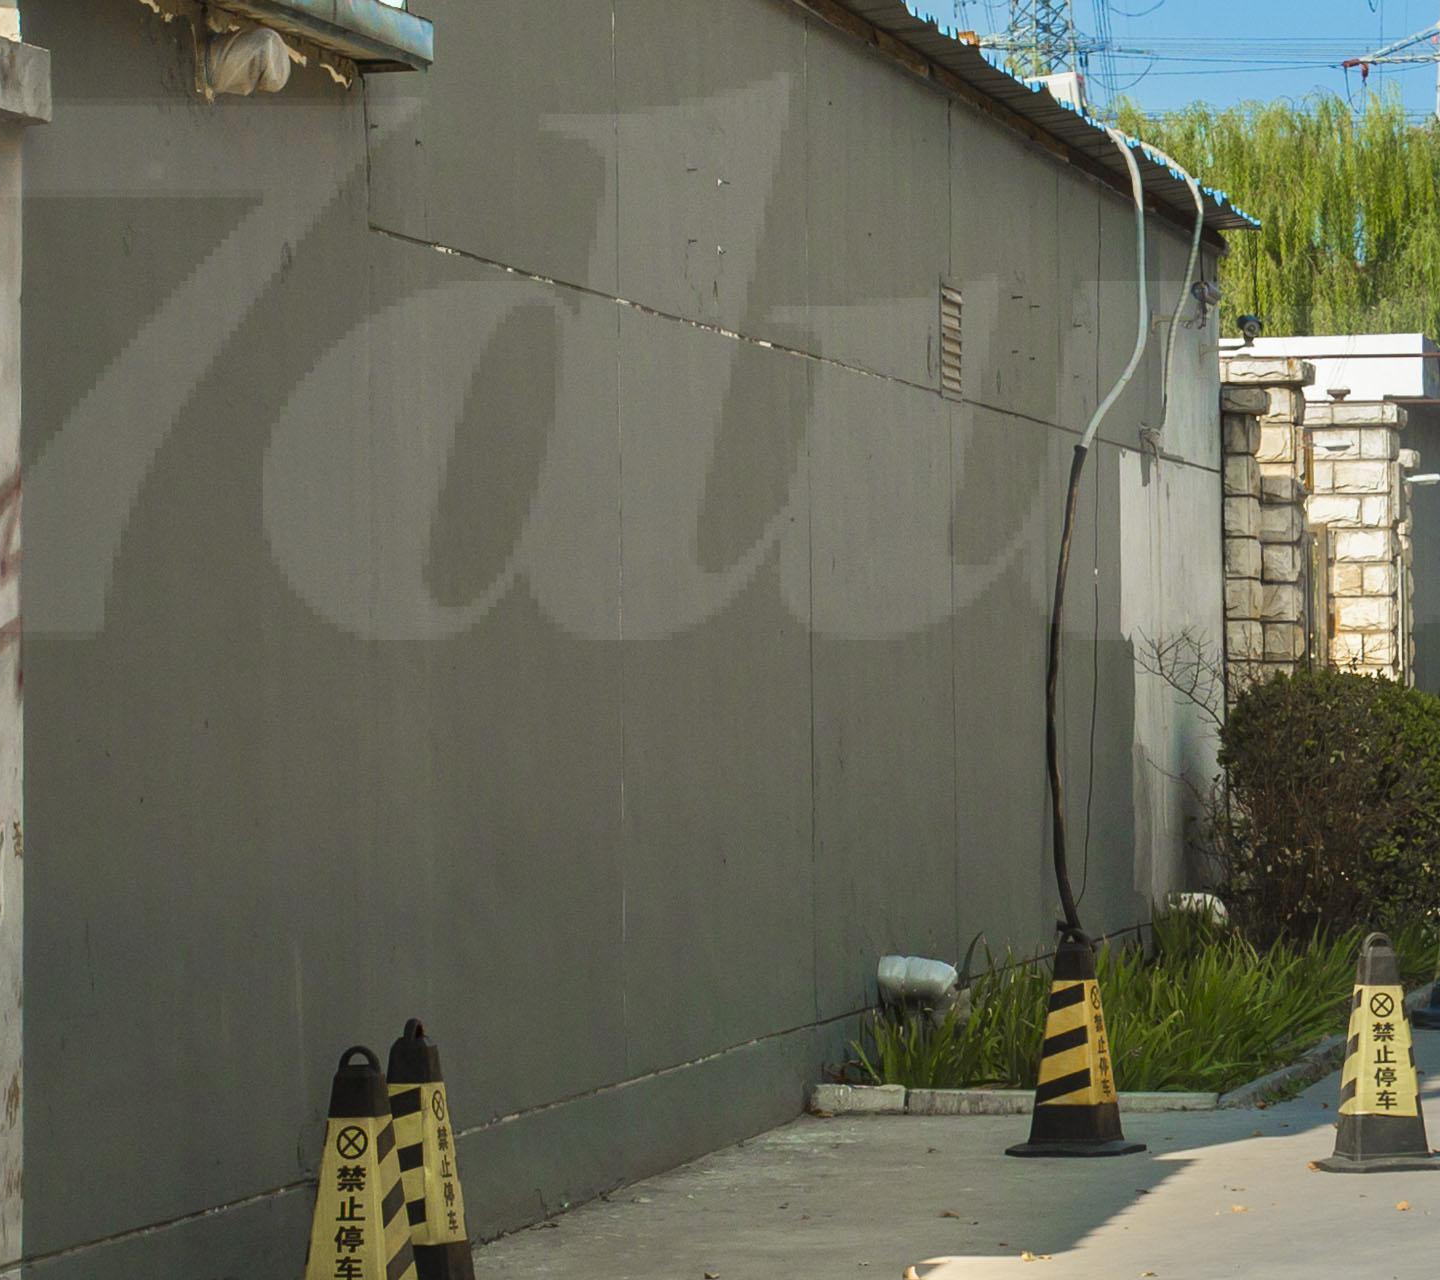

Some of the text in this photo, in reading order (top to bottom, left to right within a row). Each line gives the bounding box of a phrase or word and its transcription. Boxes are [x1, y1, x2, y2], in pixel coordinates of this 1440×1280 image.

[1094, 1015, 1112, 1098] 禁止停车
[1371, 1021, 1398, 1111] 禁止停车
[436, 1126, 459, 1234] 禁止停车
